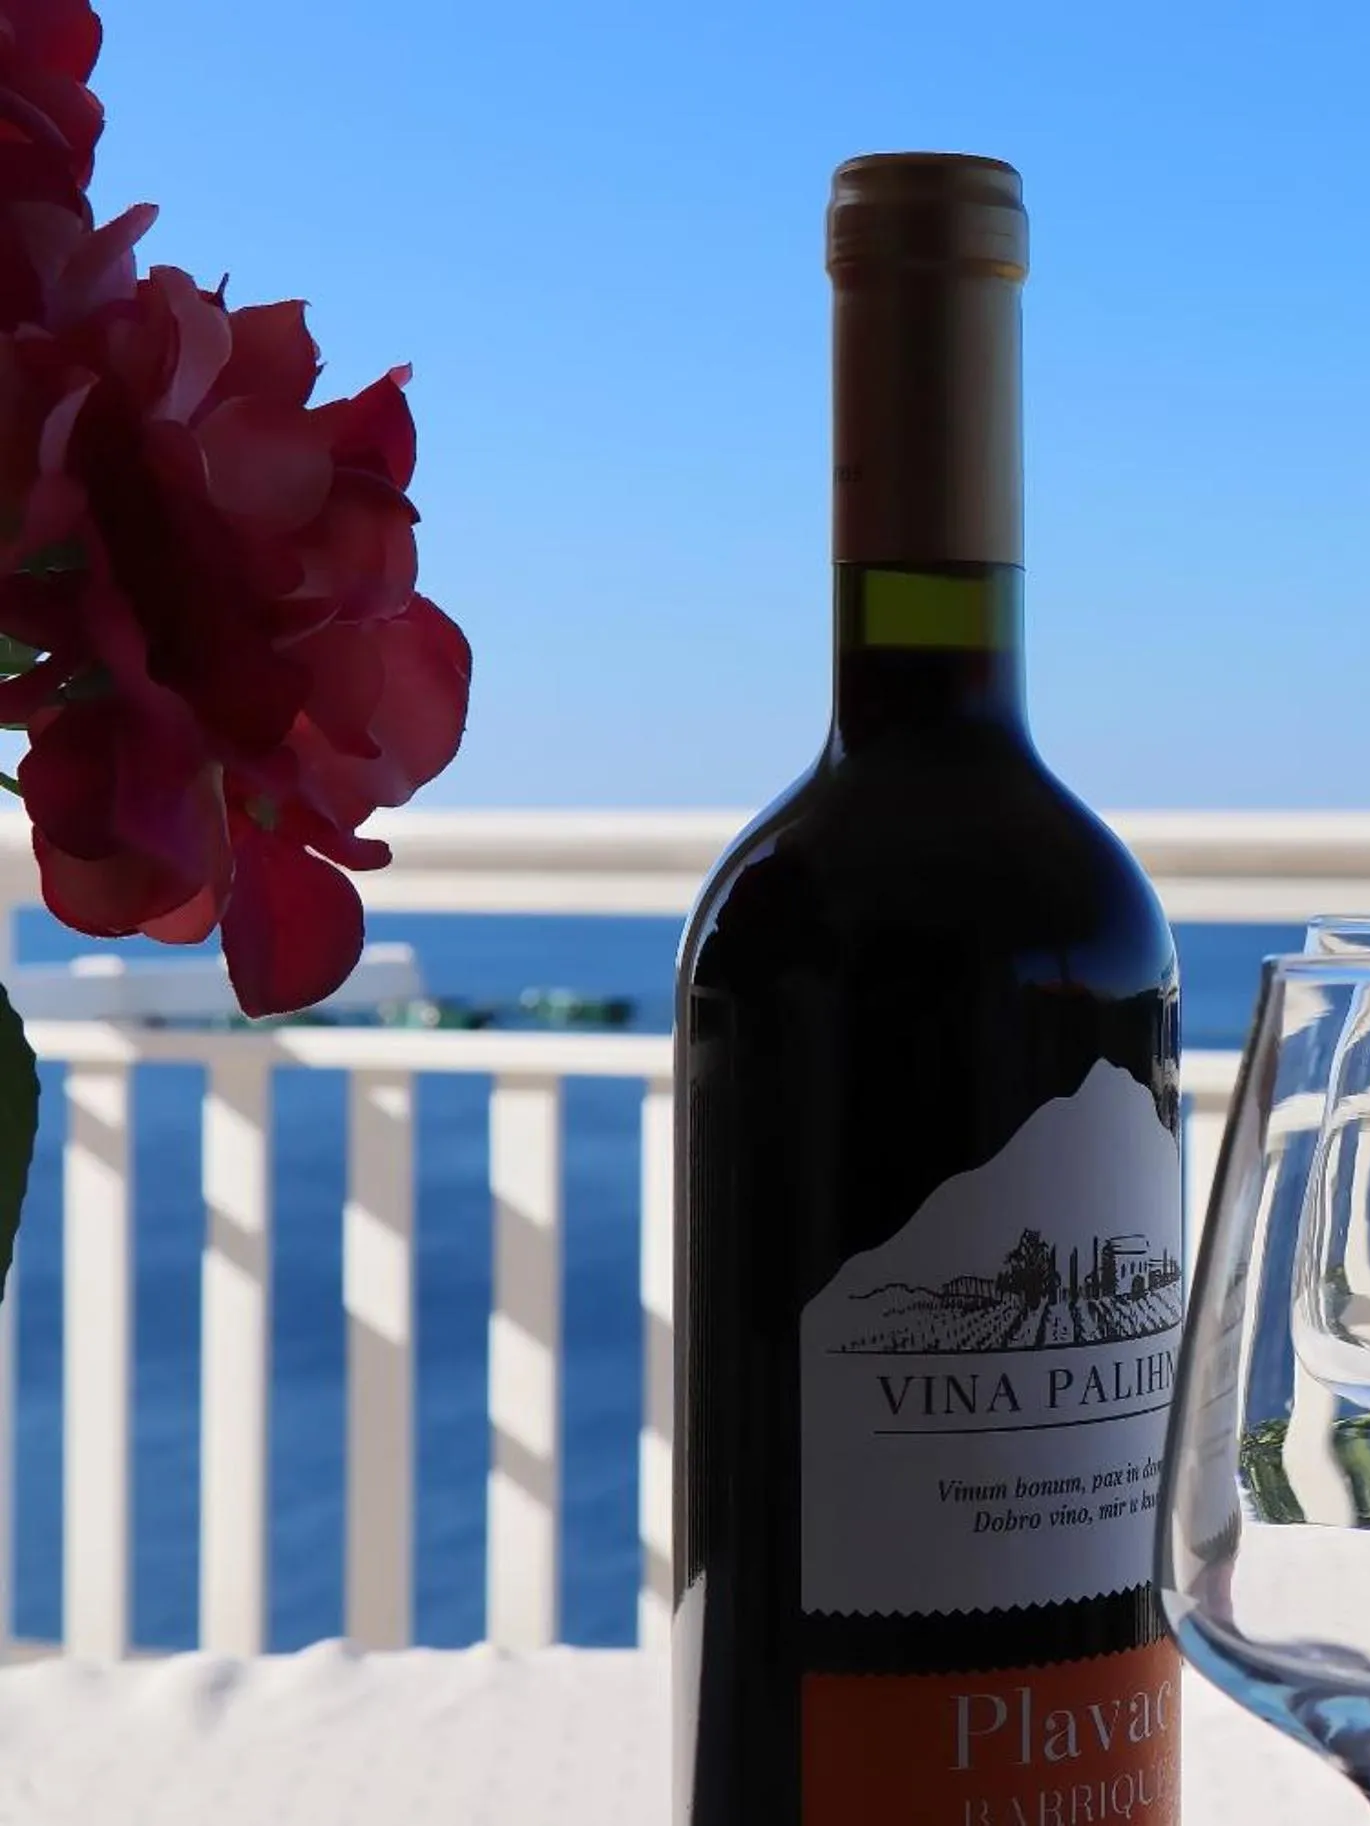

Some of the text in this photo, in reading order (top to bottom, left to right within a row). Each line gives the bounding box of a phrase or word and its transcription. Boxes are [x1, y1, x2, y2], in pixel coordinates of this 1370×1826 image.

[877, 1373, 1020, 1415] VINA
[937, 1479, 1007, 1503] Vinum
[1014, 1475, 1087, 1499] bonum,
[1092, 1469, 1123, 1494] pax
[1126, 1462, 1139, 1483] in
[973, 1509, 1041, 1534] Dobro
[1049, 1504, 1093, 1527] vino,
[1099, 1497, 1126, 1519] mir
[1129, 1497, 1139, 1514] u
[949, 1680, 1172, 1772] Plavac
